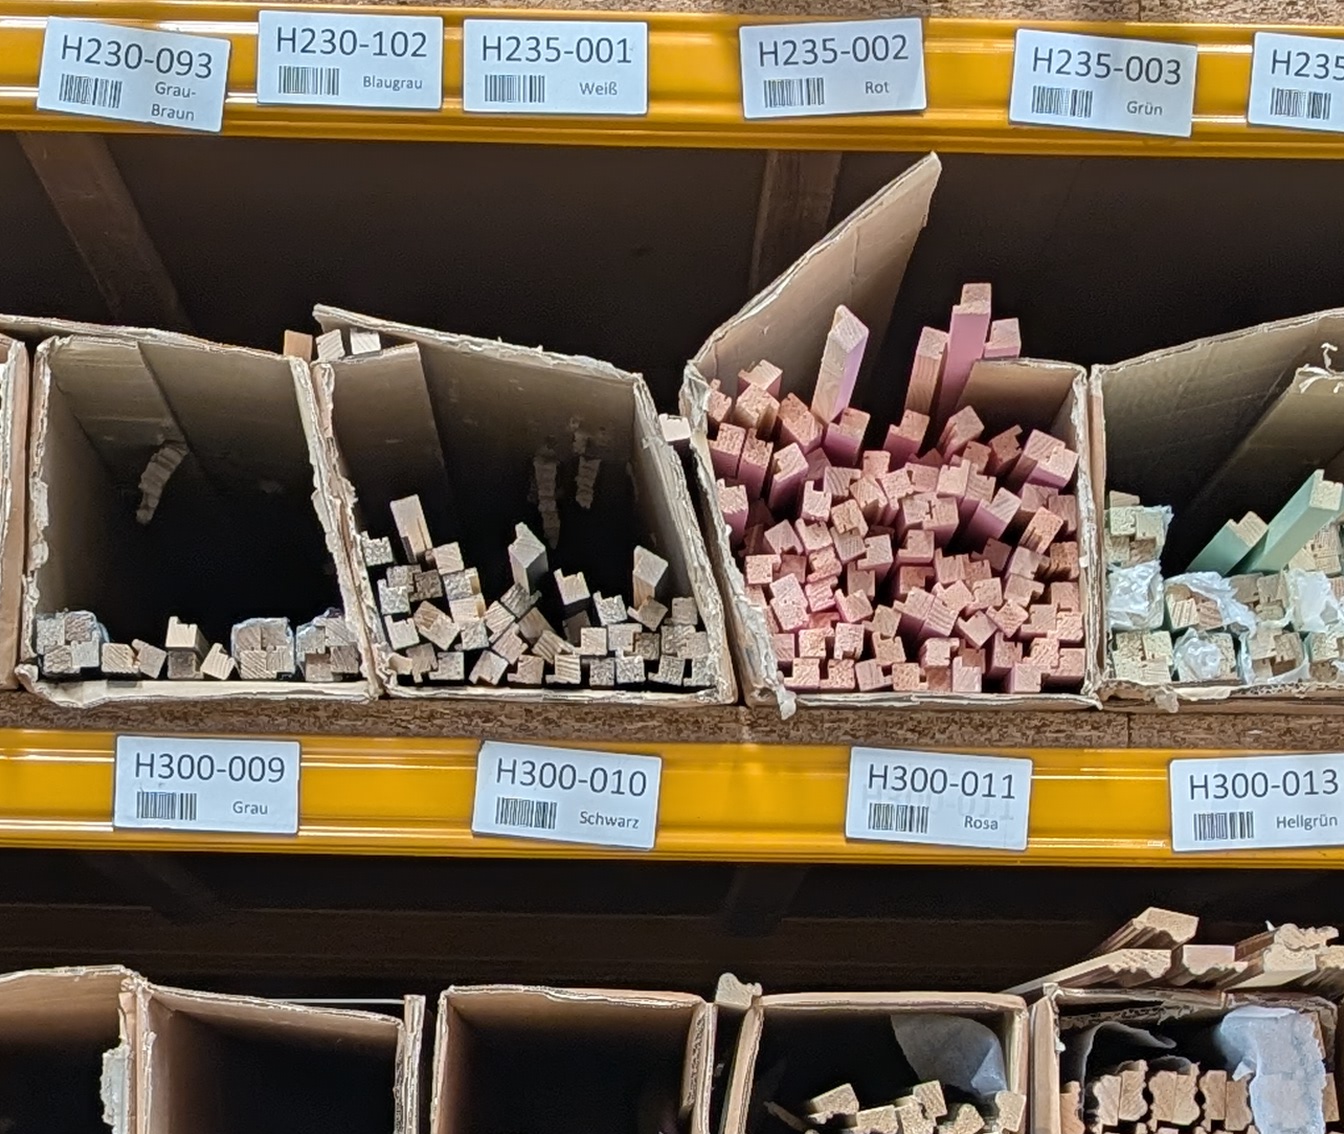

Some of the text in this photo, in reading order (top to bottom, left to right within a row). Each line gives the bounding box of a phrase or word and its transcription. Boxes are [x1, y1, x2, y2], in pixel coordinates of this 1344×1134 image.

[277, 26, 427, 58] H230-102
[482, 35, 632, 64] H235-001
[758, 34, 909, 67] H235-002
[60, 34, 214, 80] H230-093
[1032, 45, 1183, 86] H235-003
[154, 81, 197, 99] Grau-
[363, 74, 423, 92] Blaugrau
[579, 80, 618, 96] Weiß
[864, 80, 890, 95] Rot
[149, 104, 196, 123] Braun
[1126, 100, 1163, 116] Grün
[135, 752, 285, 783] H300-009
[496, 757, 648, 797] H300-010
[868, 763, 1016, 800] H300-011
[1189, 768, 1339, 801] H300-013
[232, 800, 268, 815] Grau
[579, 810, 640, 830] Schwarz
[964, 815, 999, 831] Rosa
[1276, 813, 1338, 831] Hellgrün
